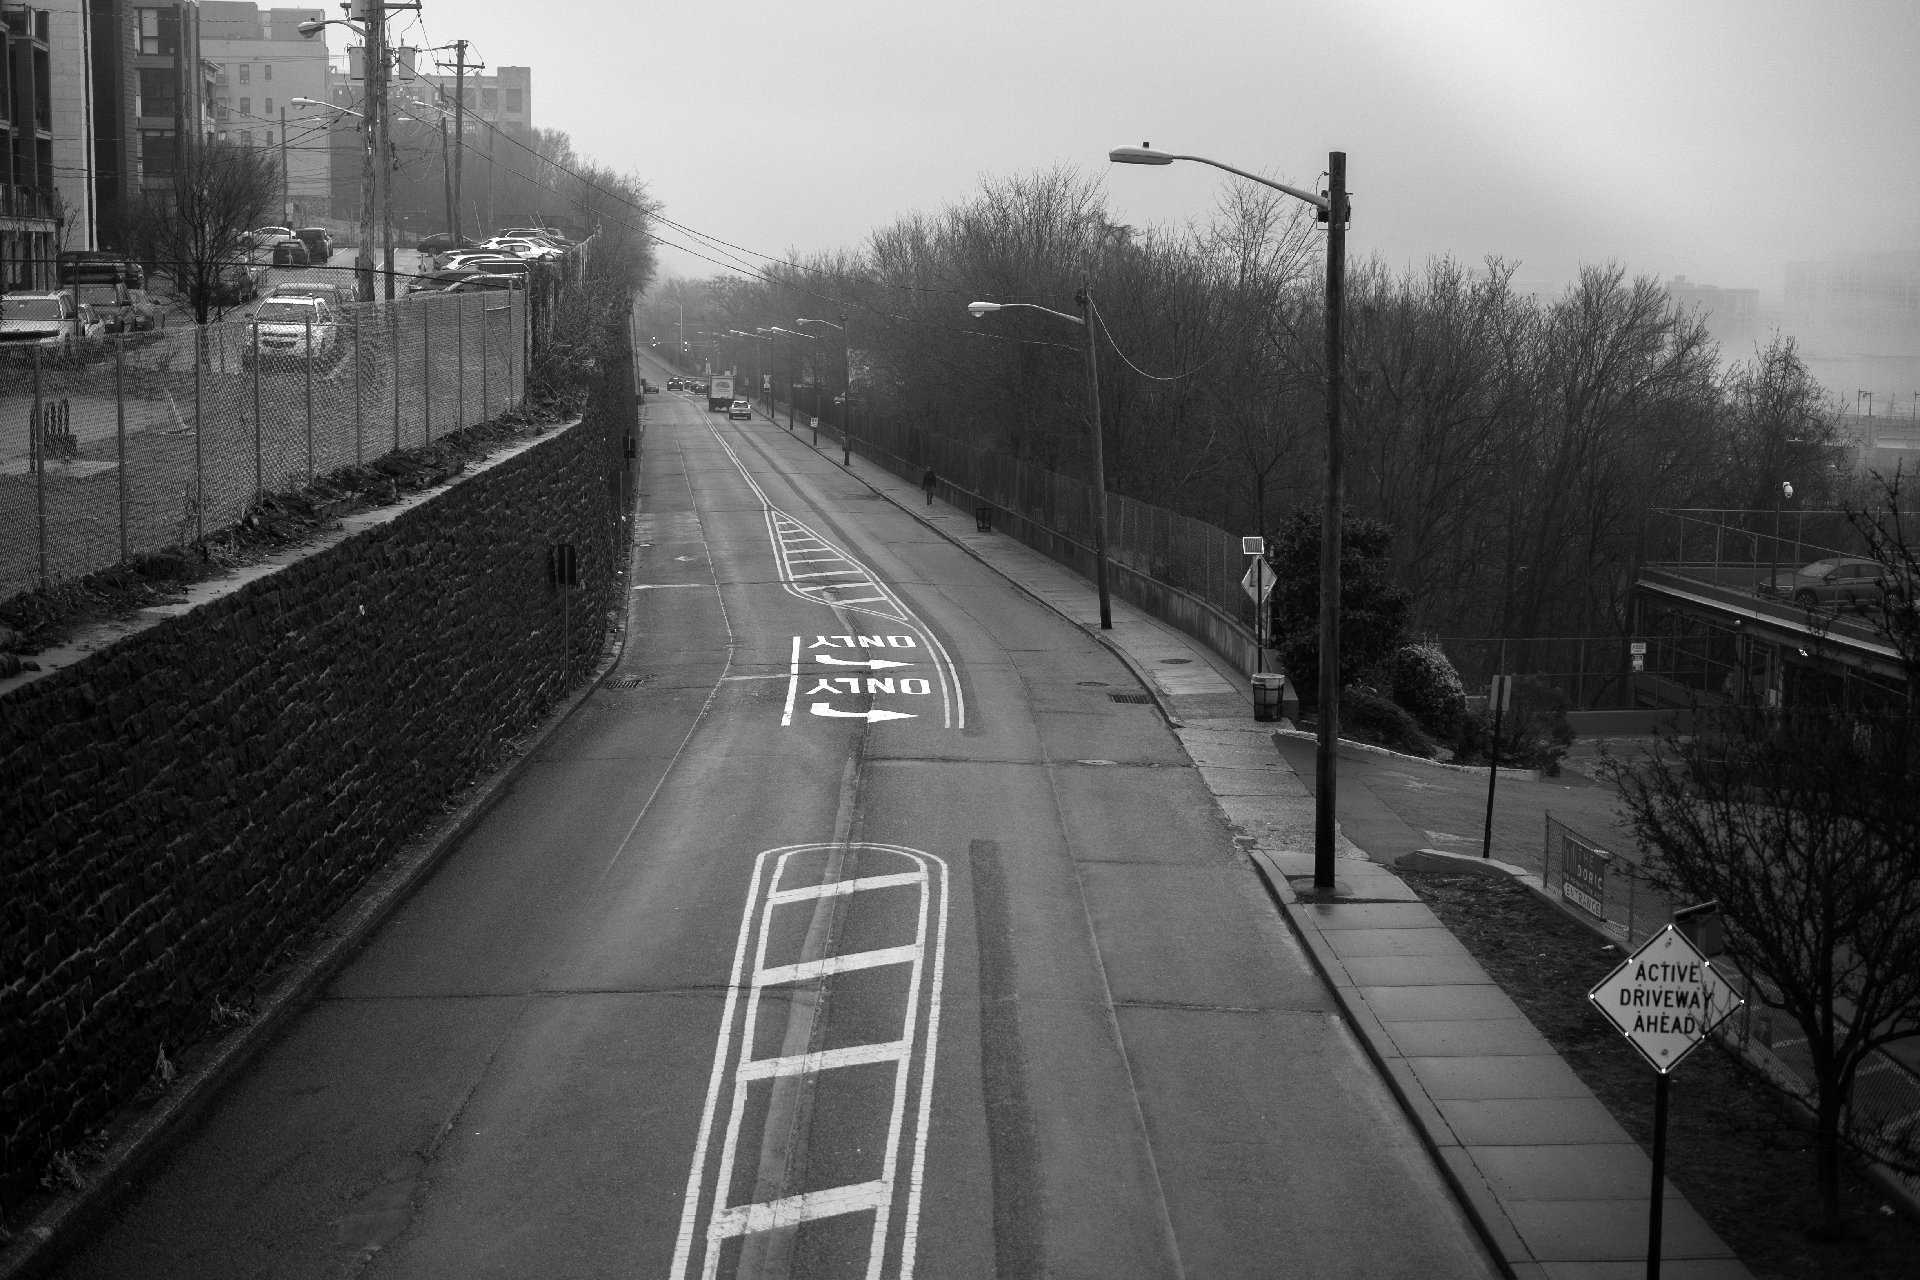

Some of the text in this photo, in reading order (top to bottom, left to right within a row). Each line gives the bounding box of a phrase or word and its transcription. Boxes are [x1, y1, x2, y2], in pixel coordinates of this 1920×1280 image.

[807, 635, 917, 648] ONLY
[805, 677, 931, 694] ONLY
[1577, 847, 1594, 868] THE
[1577, 864, 1602, 890] DORIC
[1566, 883, 1601, 916] ENTRANCE
[1635, 963, 1700, 983] ACTIVE
[1619, 988, 1713, 1009] DRIVEWAY
[1633, 1015, 1696, 1034] AHEAD
